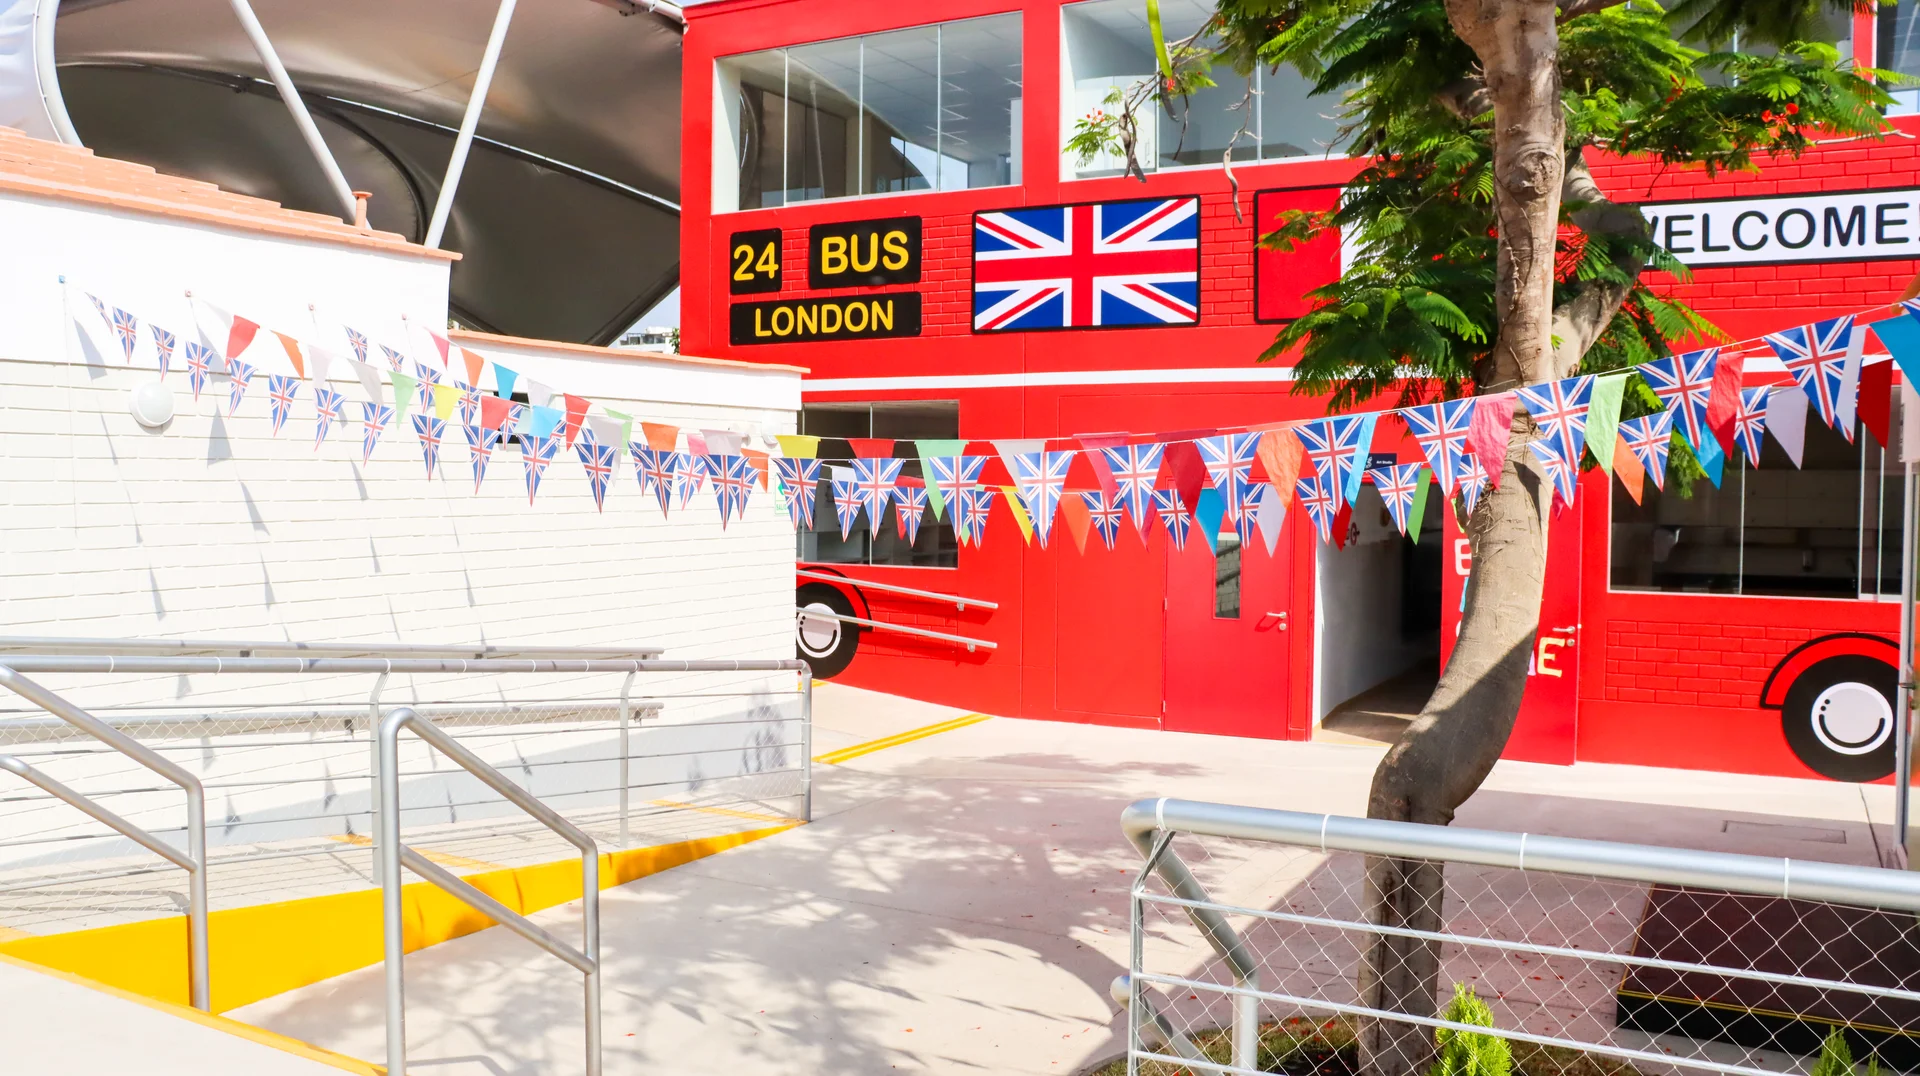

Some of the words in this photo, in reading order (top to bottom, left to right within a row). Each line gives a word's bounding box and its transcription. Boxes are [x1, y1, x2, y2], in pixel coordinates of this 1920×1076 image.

[1651, 203, 1920, 253] ELCOME
[733, 242, 779, 282] 24
[821, 230, 910, 275] BUS
[755, 300, 894, 337] LONDON
